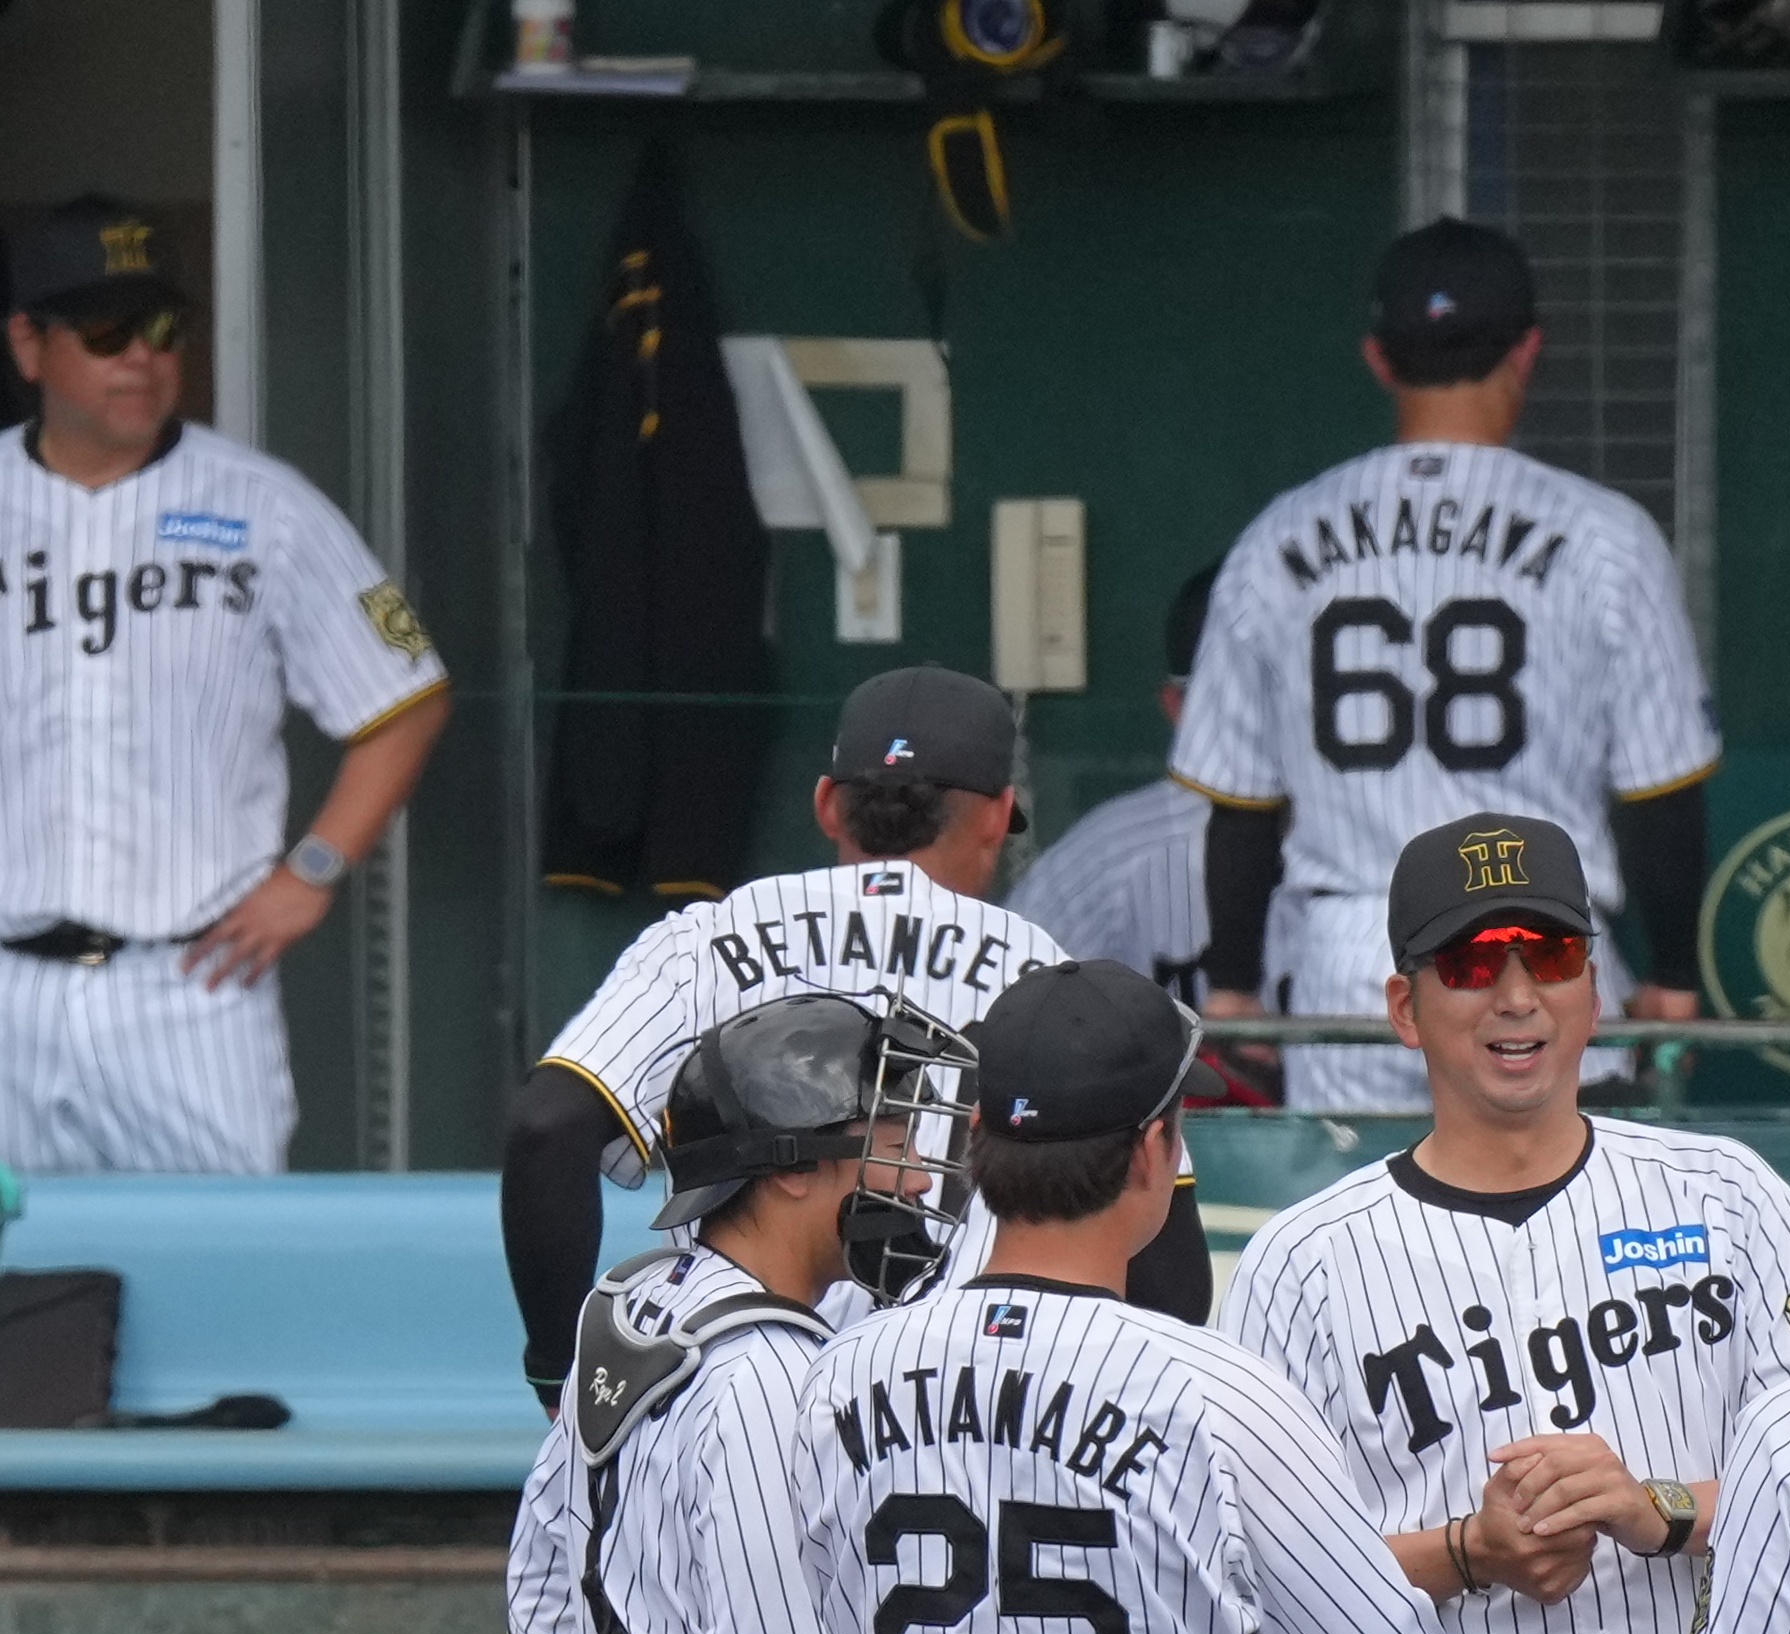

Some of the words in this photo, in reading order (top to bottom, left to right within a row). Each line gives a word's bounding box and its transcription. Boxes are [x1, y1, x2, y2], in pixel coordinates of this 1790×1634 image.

[0, 551, 259, 655] igers
[1311, 597, 1527, 773] 68
[1605, 1232, 1705, 1265] Joshin
[1363, 1274, 1735, 1454] Tigers
[833, 1366, 1170, 1501] WATANABE
